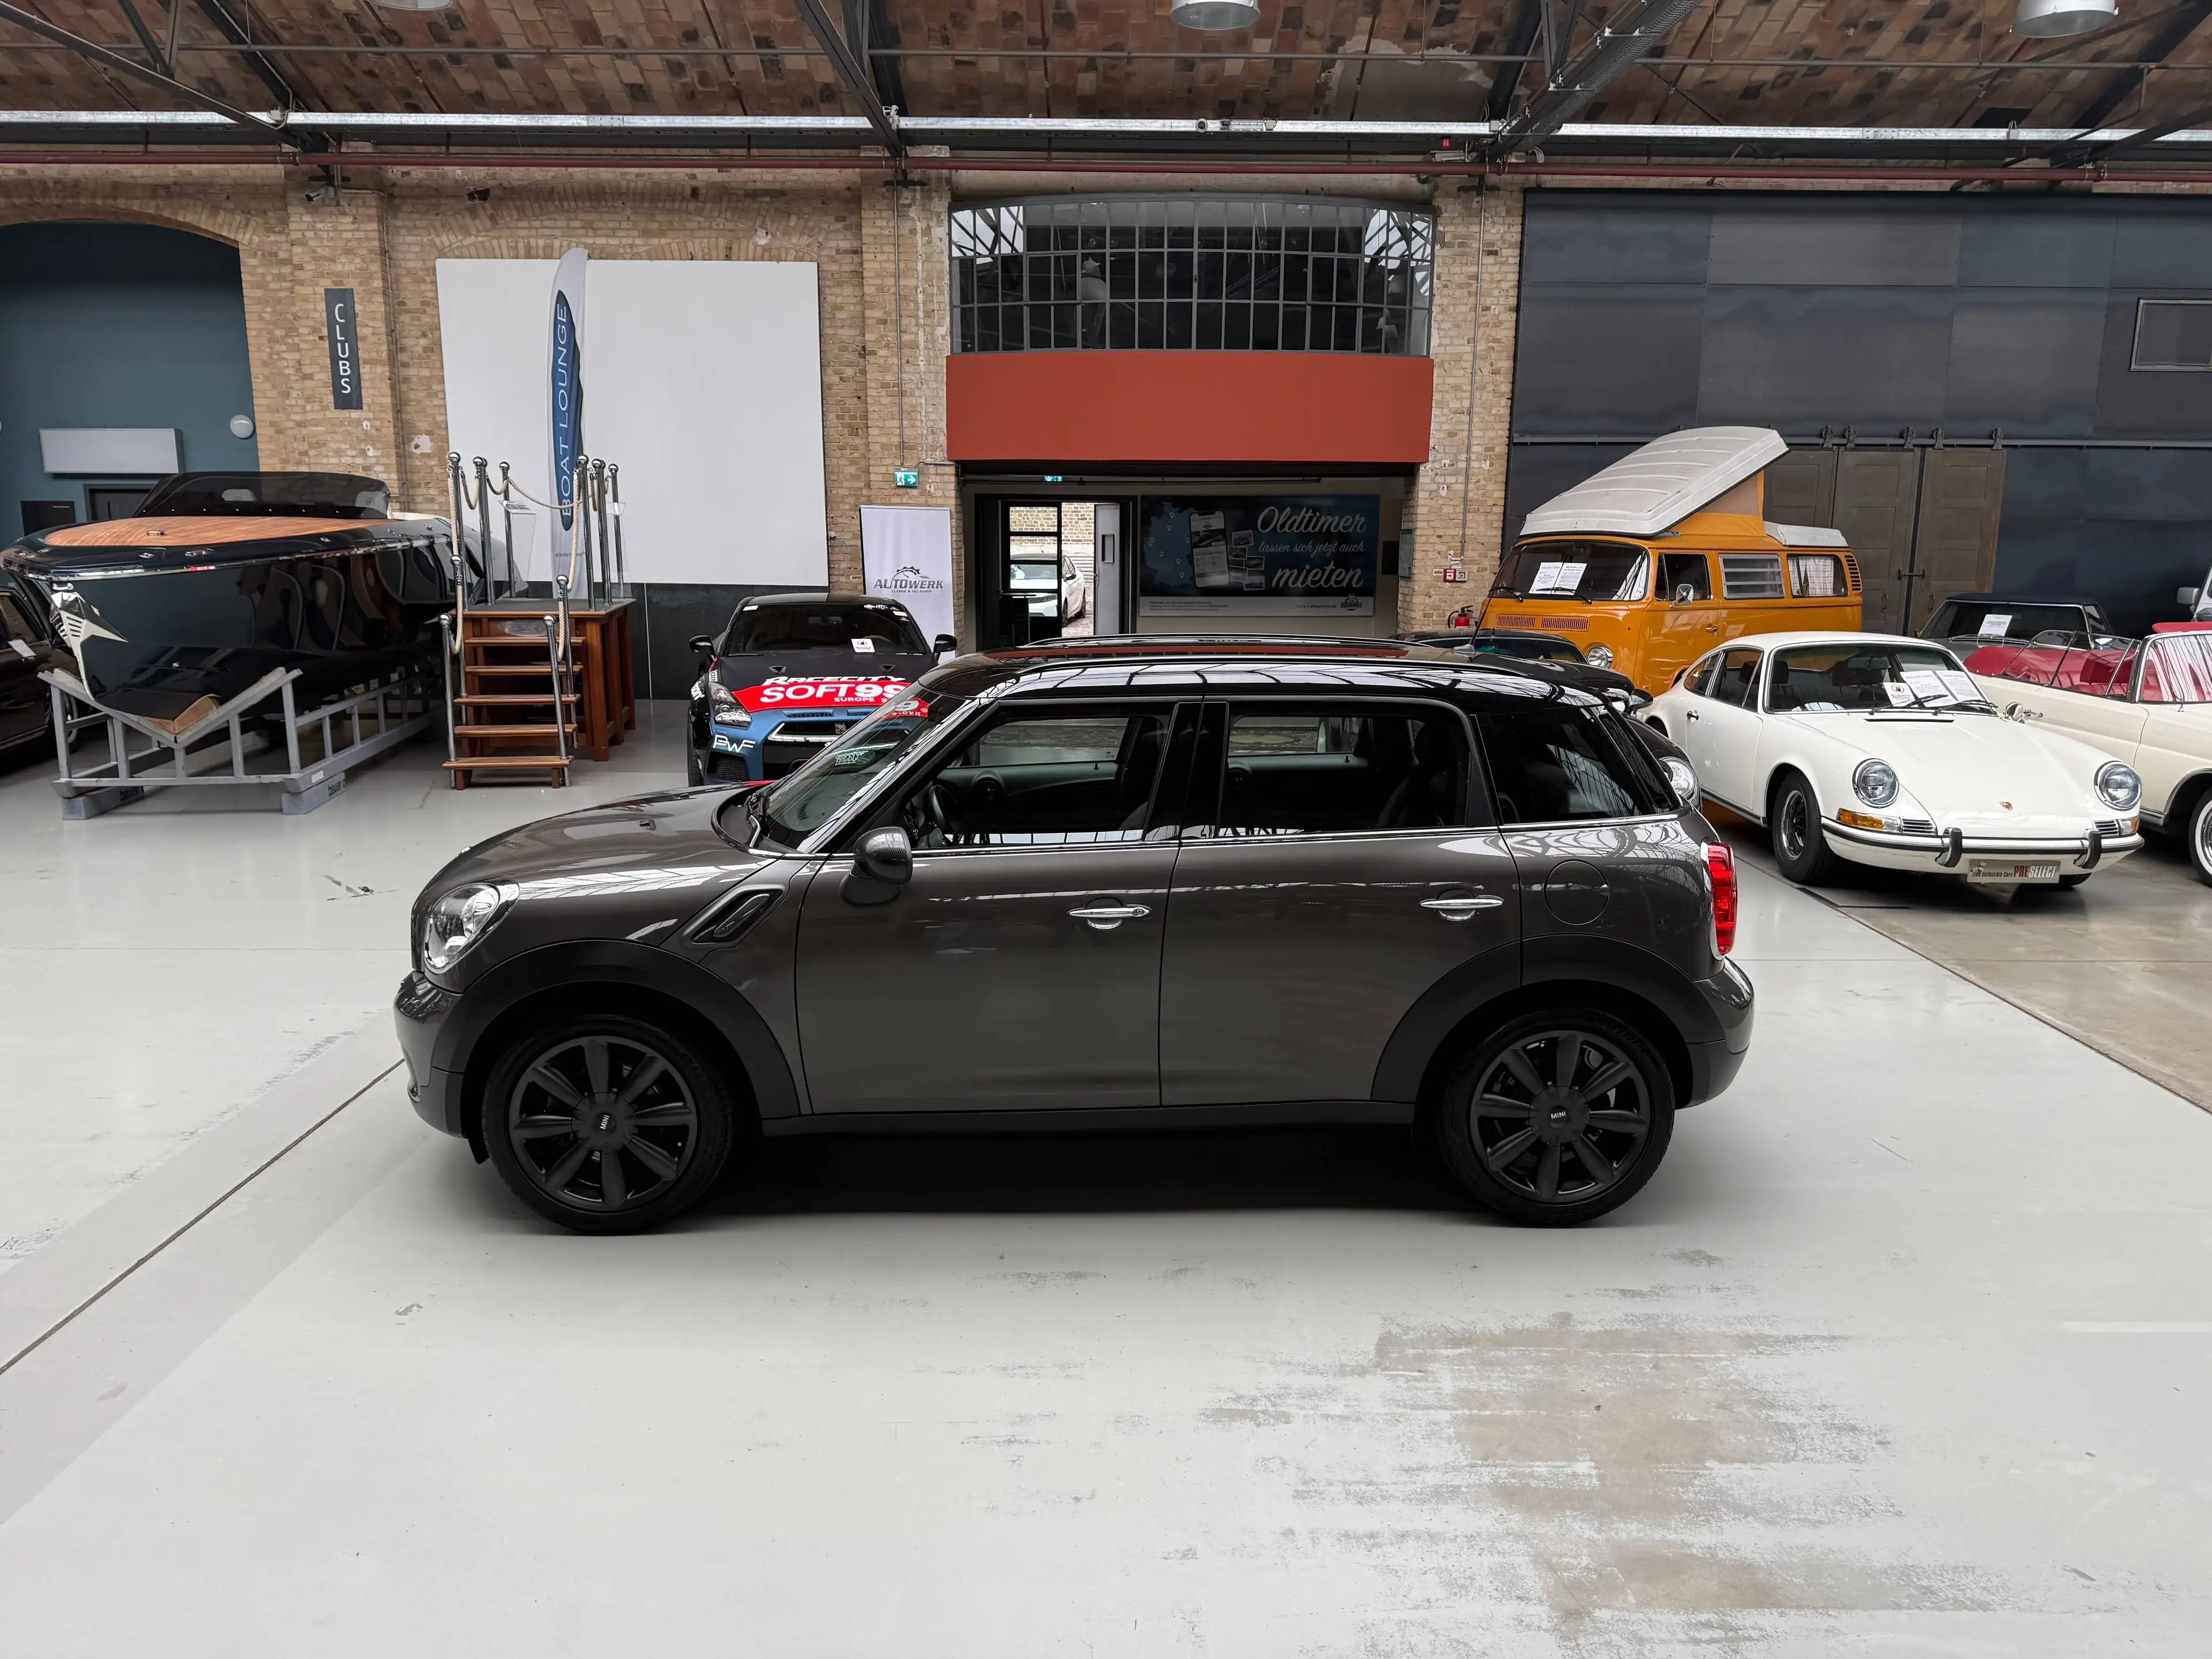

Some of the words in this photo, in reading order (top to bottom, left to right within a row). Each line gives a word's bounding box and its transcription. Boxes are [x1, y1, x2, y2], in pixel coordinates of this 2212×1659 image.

[335, 303, 351, 394] CLUBS
[557, 304, 568, 429] LOUNGE
[559, 437, 571, 516] BOAT
[1257, 506, 1366, 533] Oldtimer
[1258, 541, 1290, 552] lassen
[1293, 540, 1313, 552] sich
[1310, 543, 1338, 558] jetzt
[1339, 540, 1365, 552] auch
[873, 578, 944, 589] AUTOWERK
[1271, 560, 1363, 588] mieten
[2013, 865, 2058, 878] PRESELECT
[600, 1115, 610, 1130] MINI
[1551, 1111, 1566, 1119] MINI
